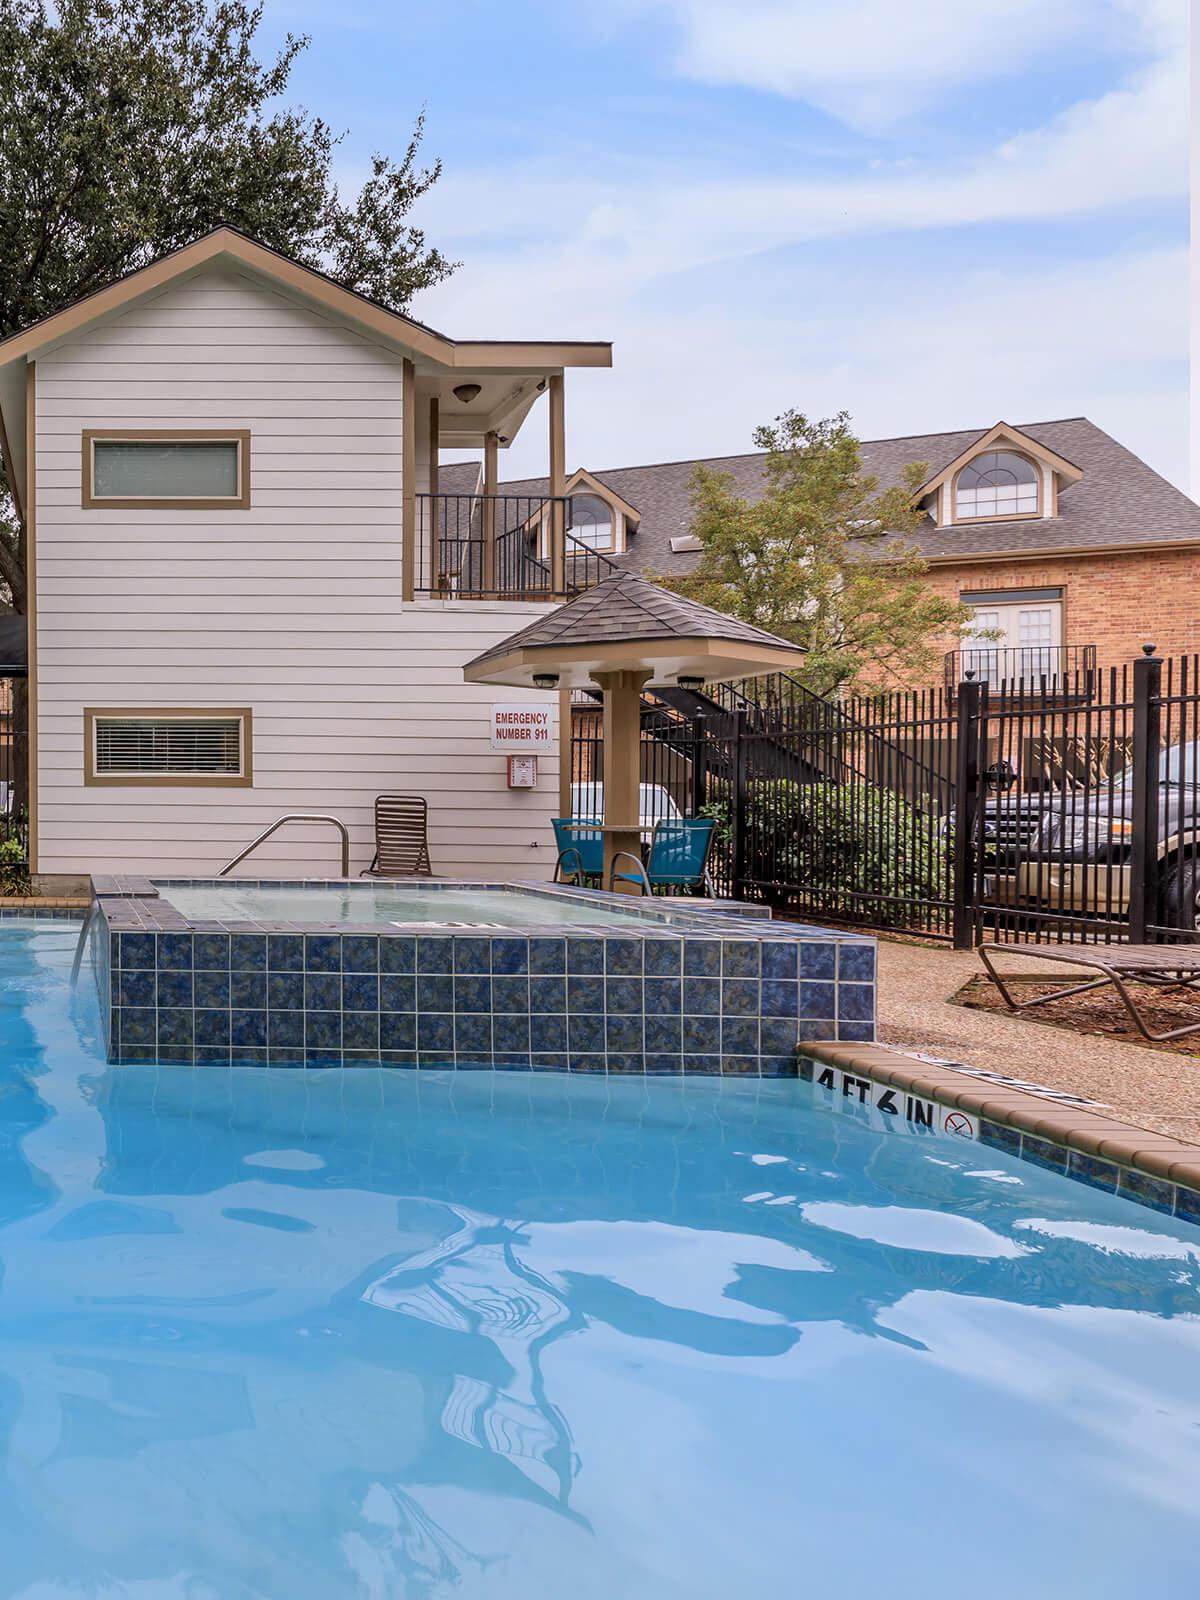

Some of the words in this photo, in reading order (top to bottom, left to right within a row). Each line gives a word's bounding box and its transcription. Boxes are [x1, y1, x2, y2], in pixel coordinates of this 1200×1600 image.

[496, 712, 548, 724] EMERGENCY
[496, 728, 532, 740] NUMBER
[535, 728, 548, 740] 911
[817, 1068, 836, 1090] 4
[843, 1075, 870, 1104] FT
[877, 1091, 898, 1115] 6
[906, 1096, 933, 1128] IN
